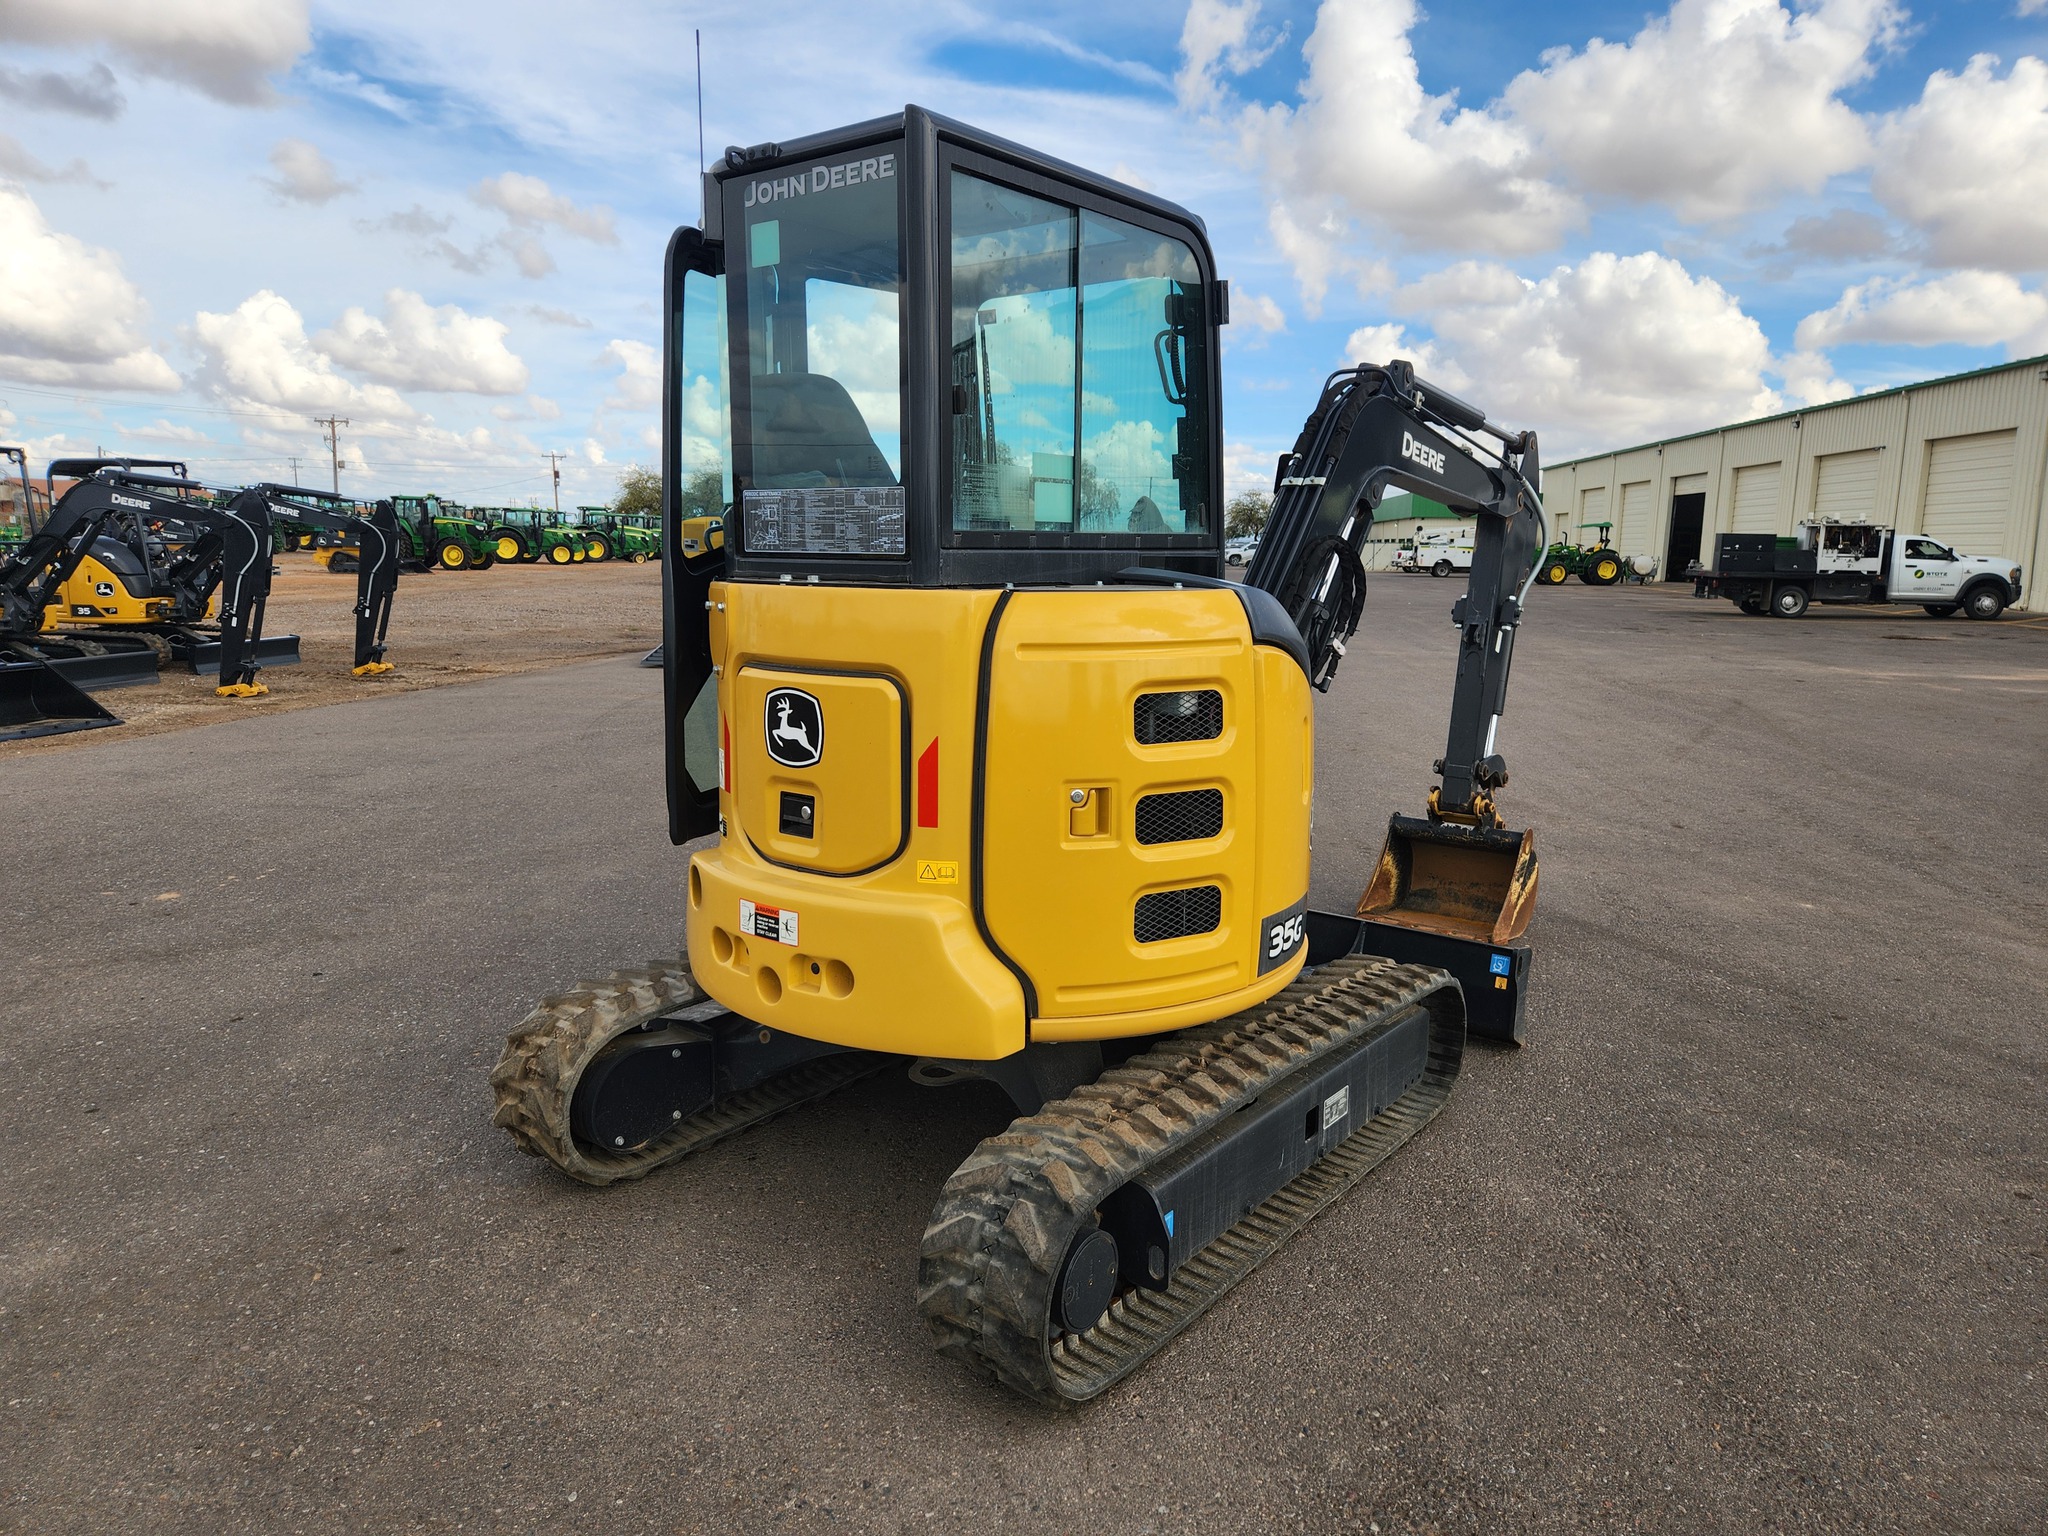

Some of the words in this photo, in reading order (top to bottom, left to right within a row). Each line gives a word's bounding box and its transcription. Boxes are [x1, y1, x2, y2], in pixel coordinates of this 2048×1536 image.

[744, 174, 806, 208] JOHN
[812, 153, 895, 193] DEERE
[1401, 430, 1446, 475] DEERE
[111, 493, 151, 511] DEERE
[77, 607, 91, 615] 35
[1268, 913, 1304, 959] 35G
